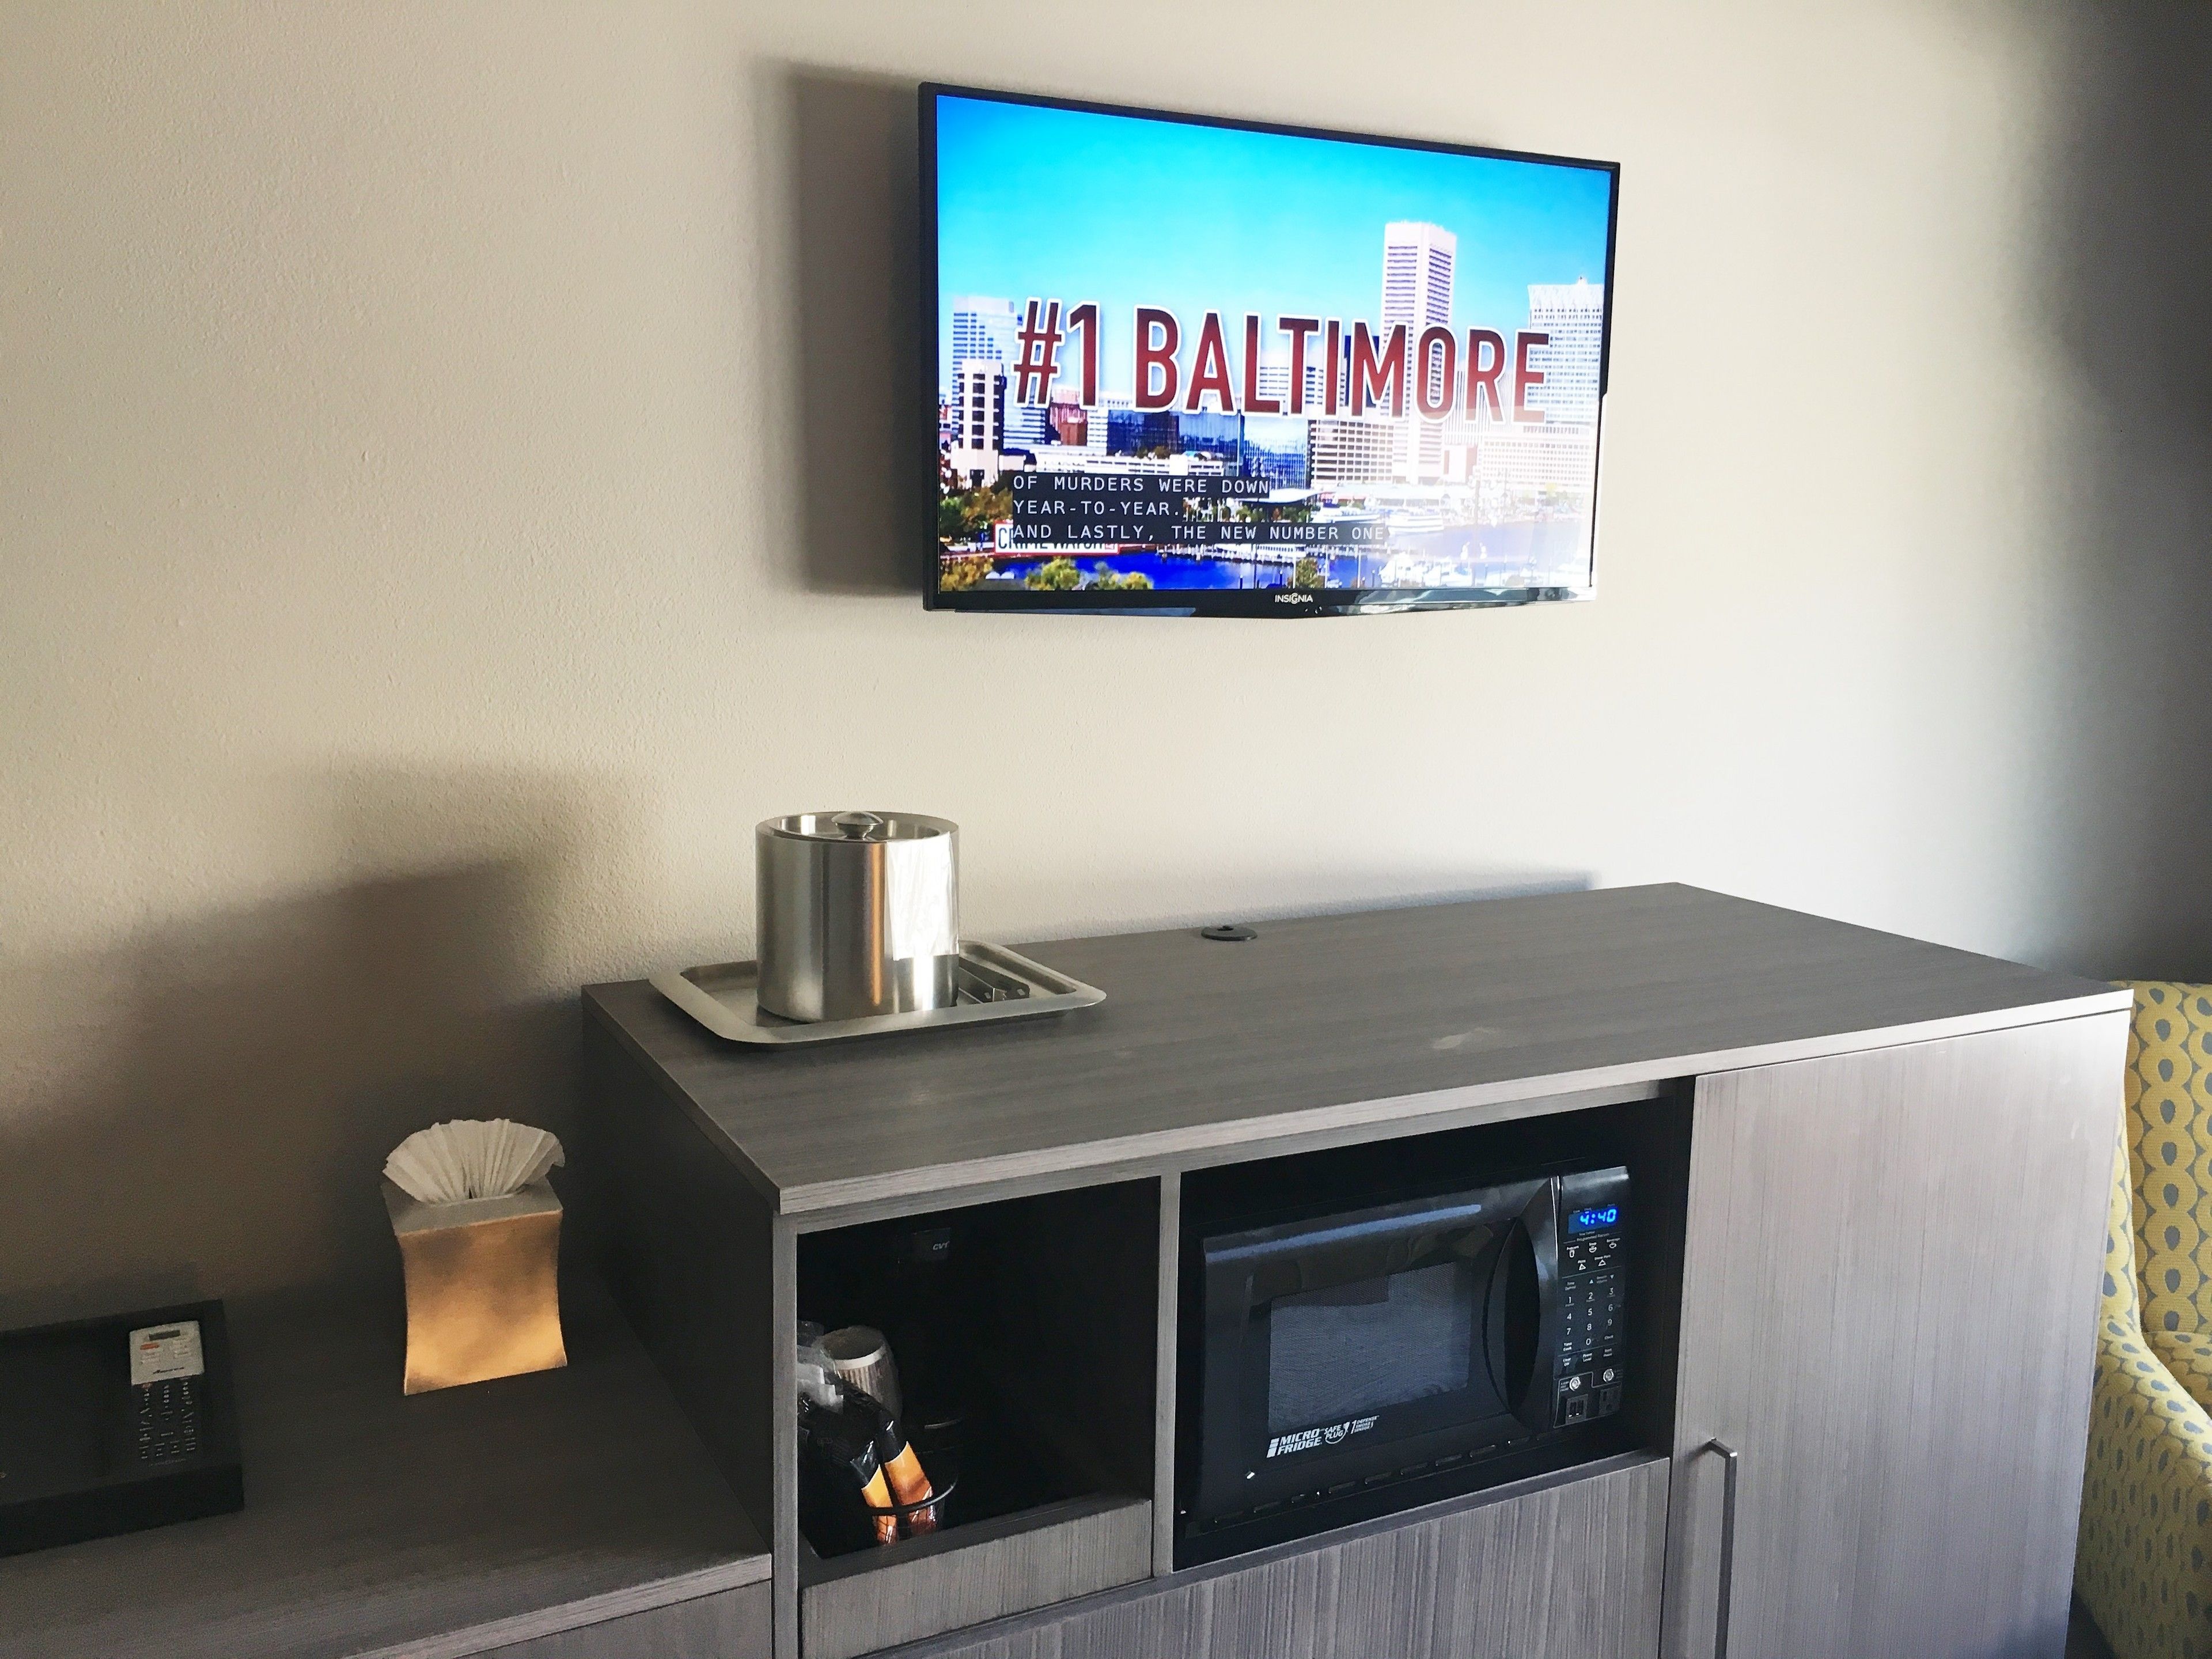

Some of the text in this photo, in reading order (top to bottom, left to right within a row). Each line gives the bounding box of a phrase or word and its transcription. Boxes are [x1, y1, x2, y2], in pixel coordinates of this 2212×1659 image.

[1012, 298, 1551, 425] #1 BALTIMORE
[1013, 475, 1268, 494] OF MURDERS WERE DOWN
[1013, 499, 1179, 516] YEAR-TO-YEAR.
[1013, 524, 1052, 539] AND
[1067, 524, 1154, 541] LASTLY,
[1171, 525, 1206, 539] THE
[1221, 525, 1257, 540] NEW
[1270, 526, 1339, 540] NUMBER
[1351, 527, 1384, 540] ONE
[1274, 592, 1313, 605] INSIGNIA
[1580, 1209, 1617, 1225] 4:40
[1588, 1291, 1593, 1300] 2
[1609, 1287, 1613, 1295] 3
[1588, 1308, 1593, 1316] 5
[1608, 1304, 1613, 1312] 6
[1607, 1318, 1612, 1326] 9
[1566, 1327, 1571, 1335] 7
[1585, 1338, 1591, 1346] 0
[1324, 1424, 1342, 1434] SAFE
[1325, 1429, 1344, 1440] PLUG
[1279, 1428, 1320, 1445] MICRO
[1277, 1436, 1321, 1456] FRIDGE
